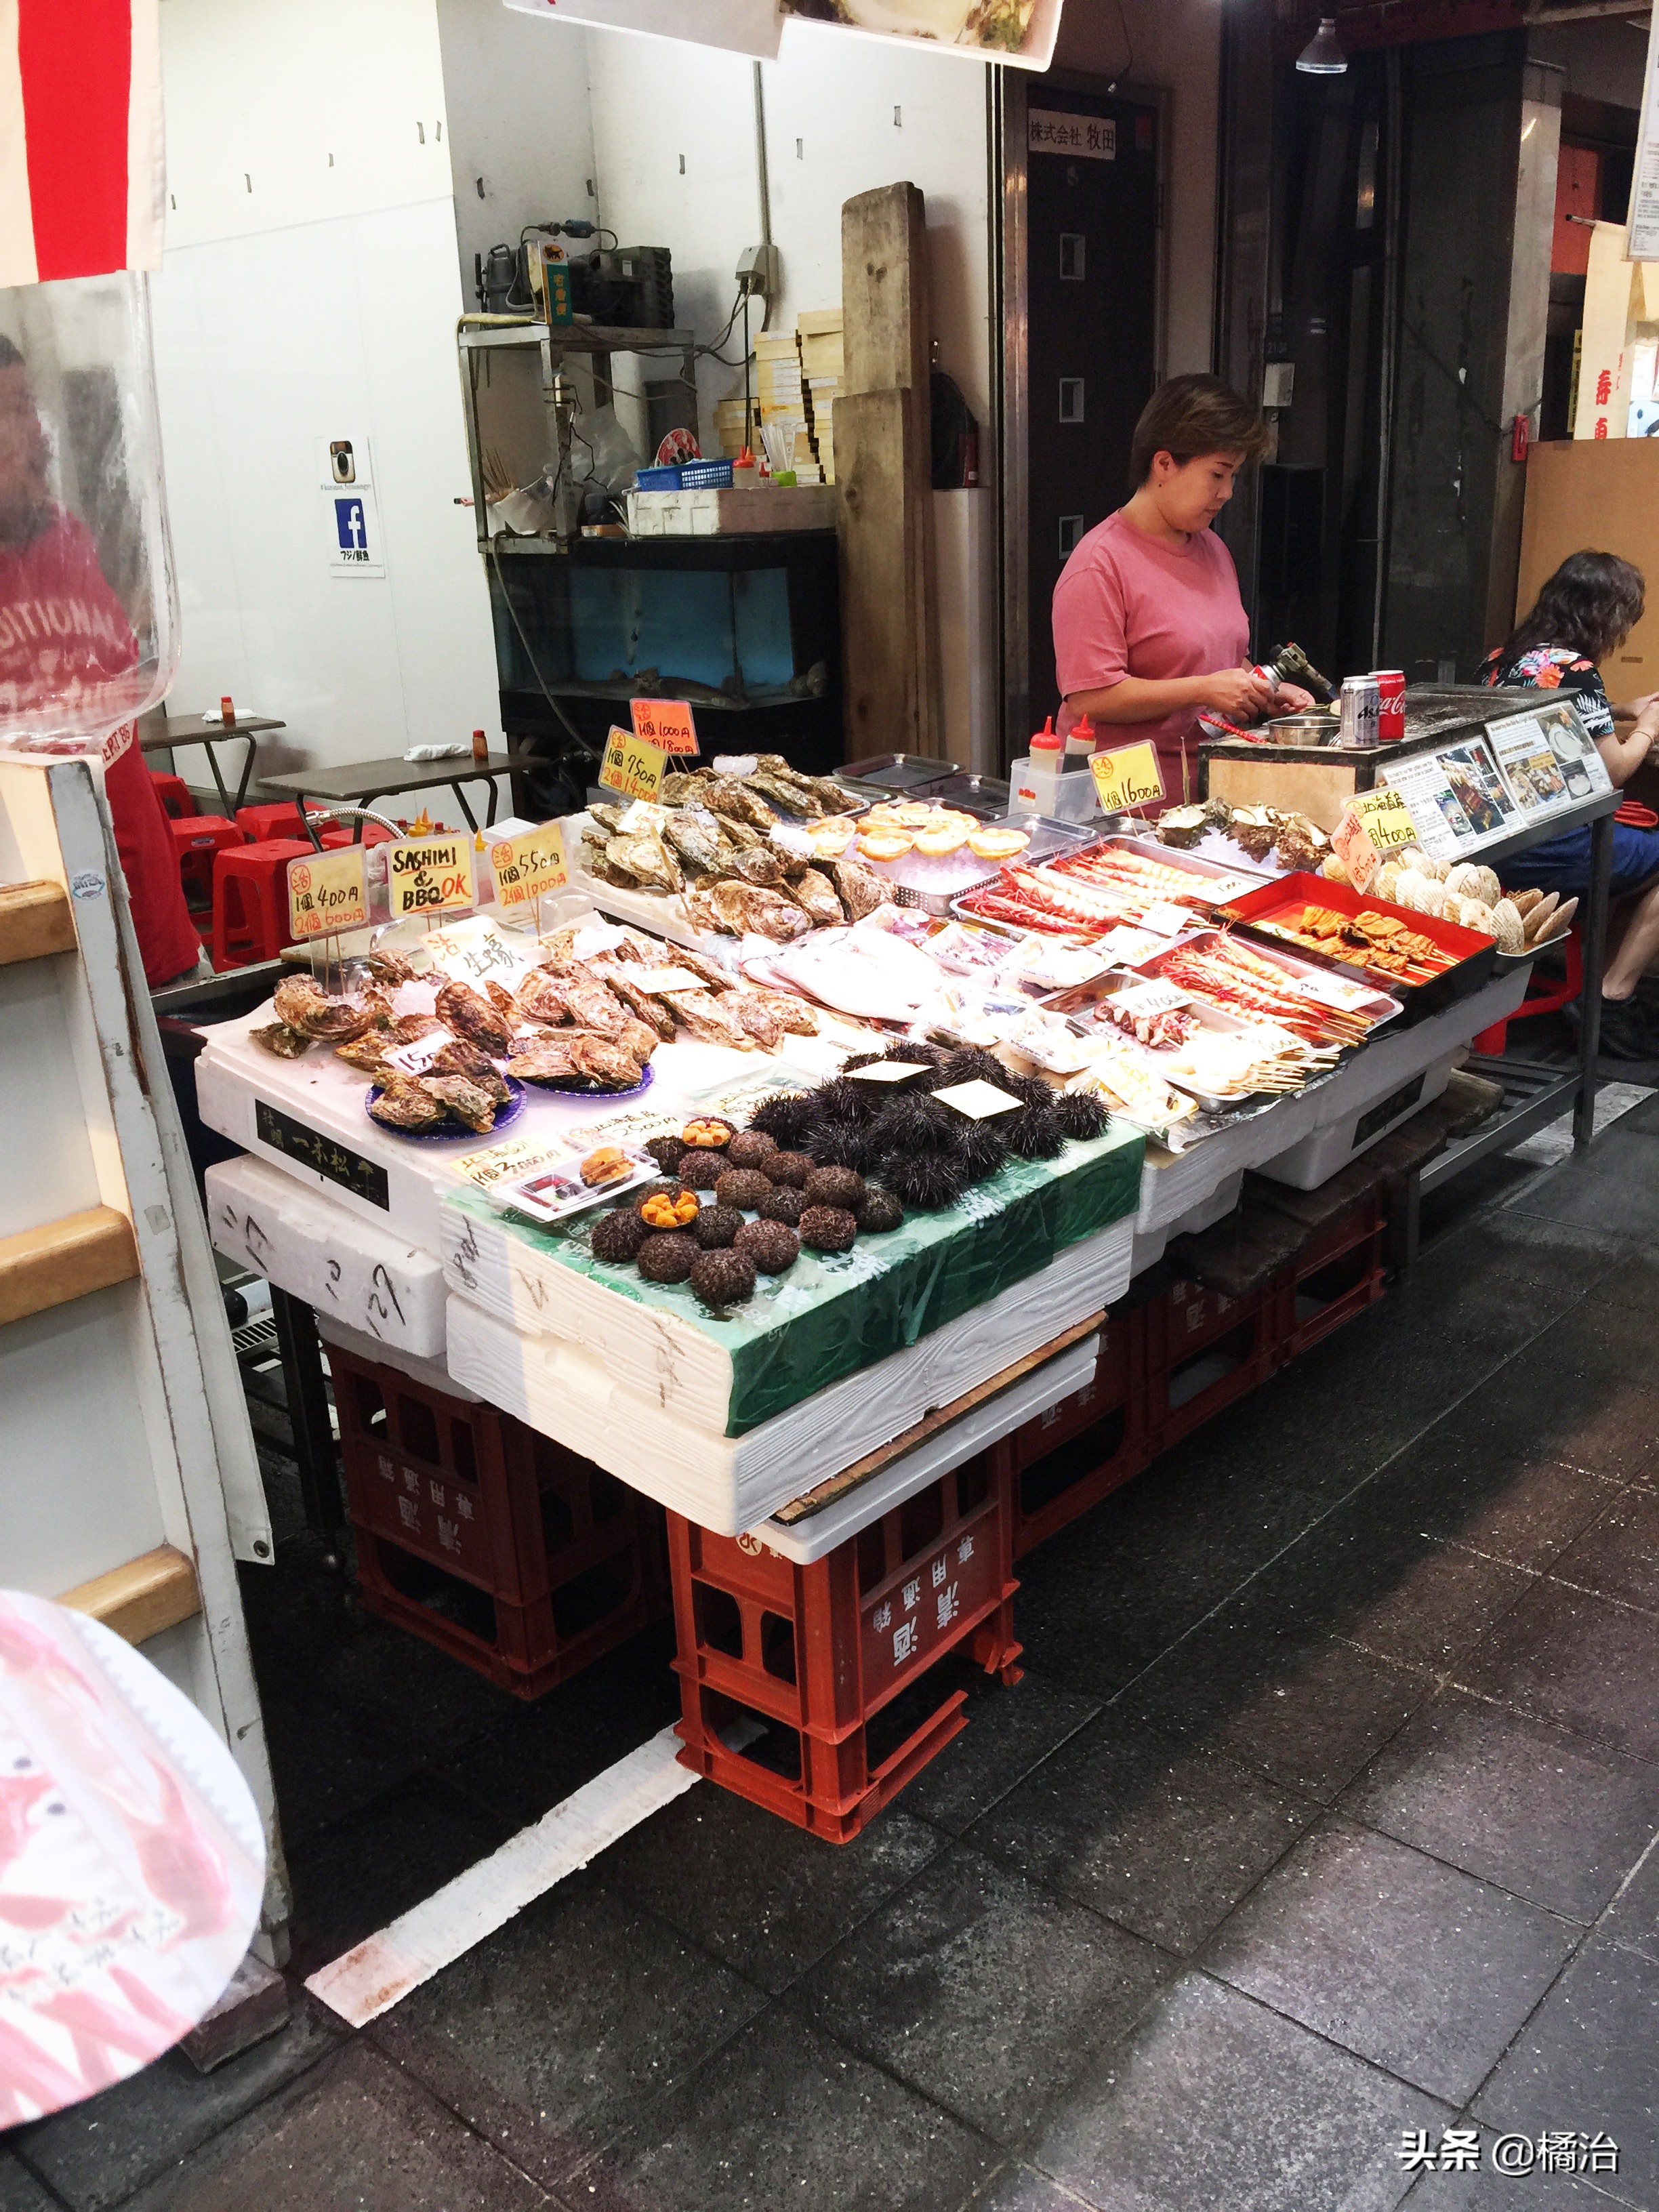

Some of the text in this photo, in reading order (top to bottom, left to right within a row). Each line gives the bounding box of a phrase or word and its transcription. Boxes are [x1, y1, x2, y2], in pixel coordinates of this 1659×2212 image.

[1030, 120, 1115, 152] 株式会社 牧田
[392, 846, 457, 873] SASHIMI
[403, 873, 472, 911] BBQ OK
[413, 870, 434, 888] &
[893, 1580, 960, 1666] 清酒
